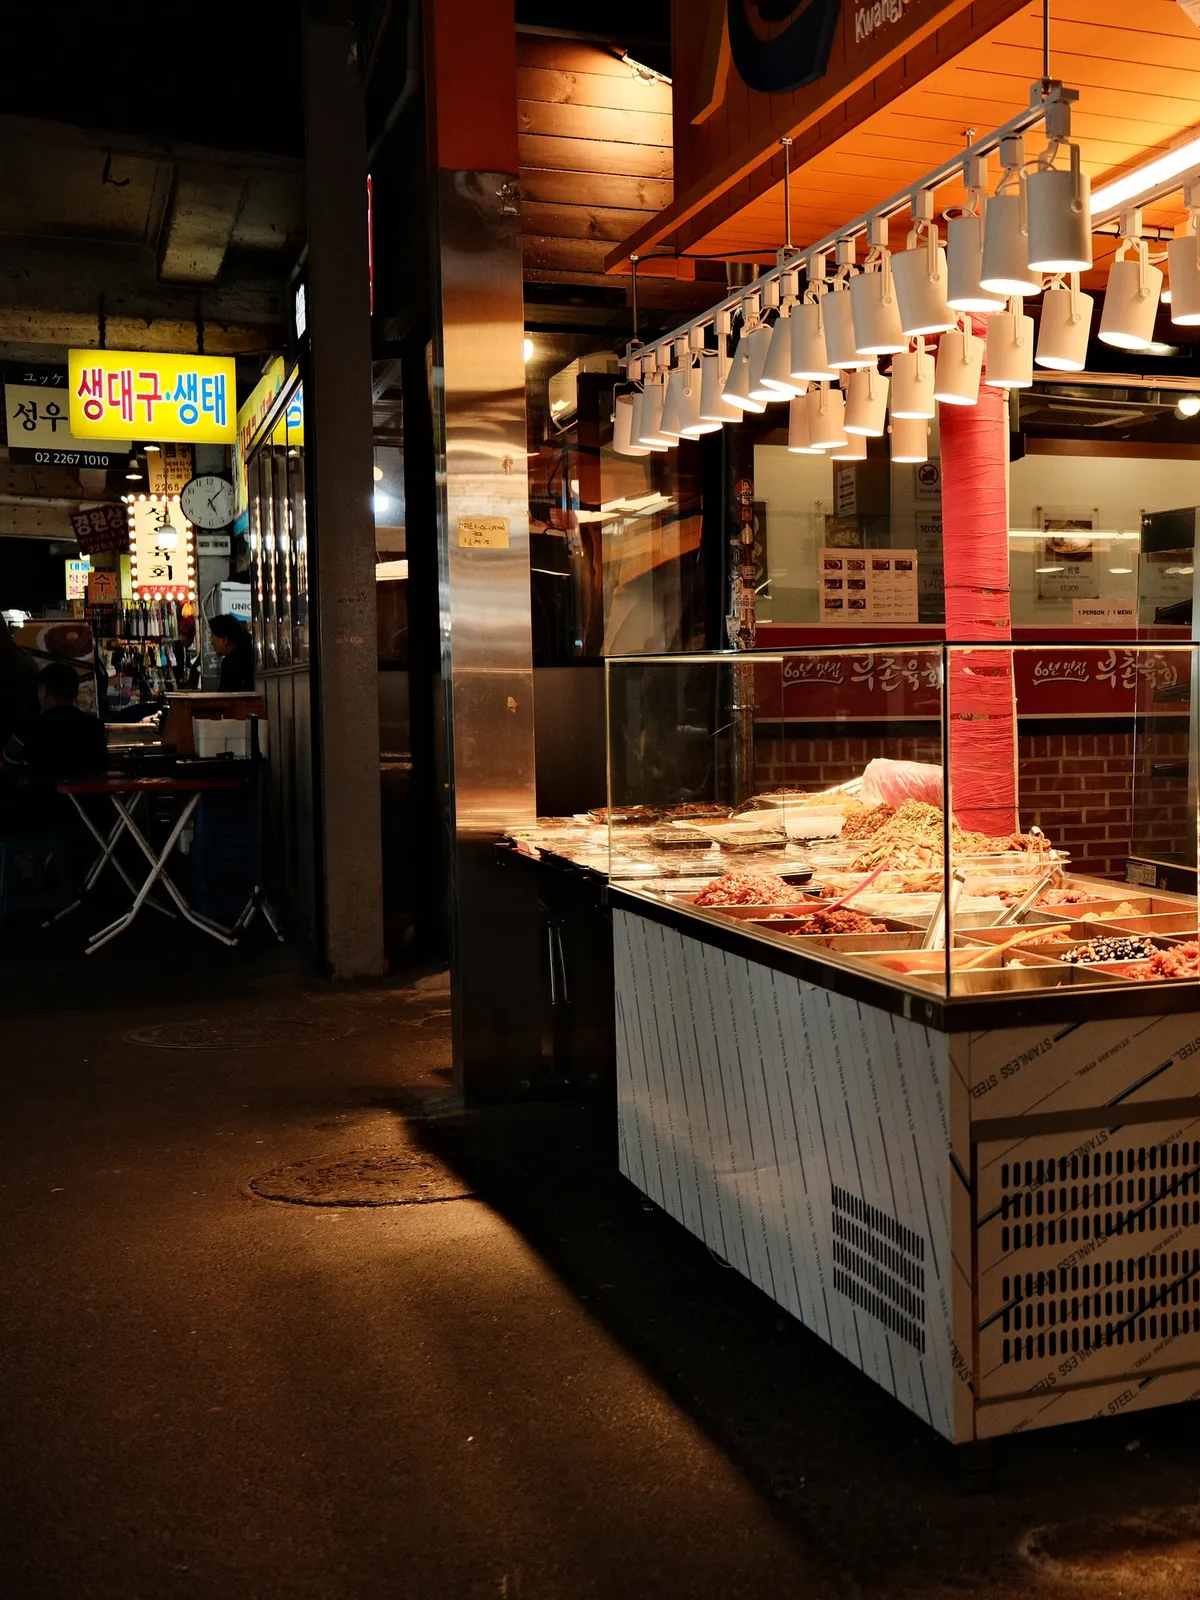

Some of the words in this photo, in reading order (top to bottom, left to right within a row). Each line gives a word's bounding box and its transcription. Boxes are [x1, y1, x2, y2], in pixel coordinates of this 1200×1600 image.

[35, 452, 51, 464] 02
[53, 453, 80, 465] 2267
[83, 454, 109, 466] 1010
[1000, 1037, 1054, 1080] STAINLESS
[1108, 1388, 1139, 1414] STEEL
